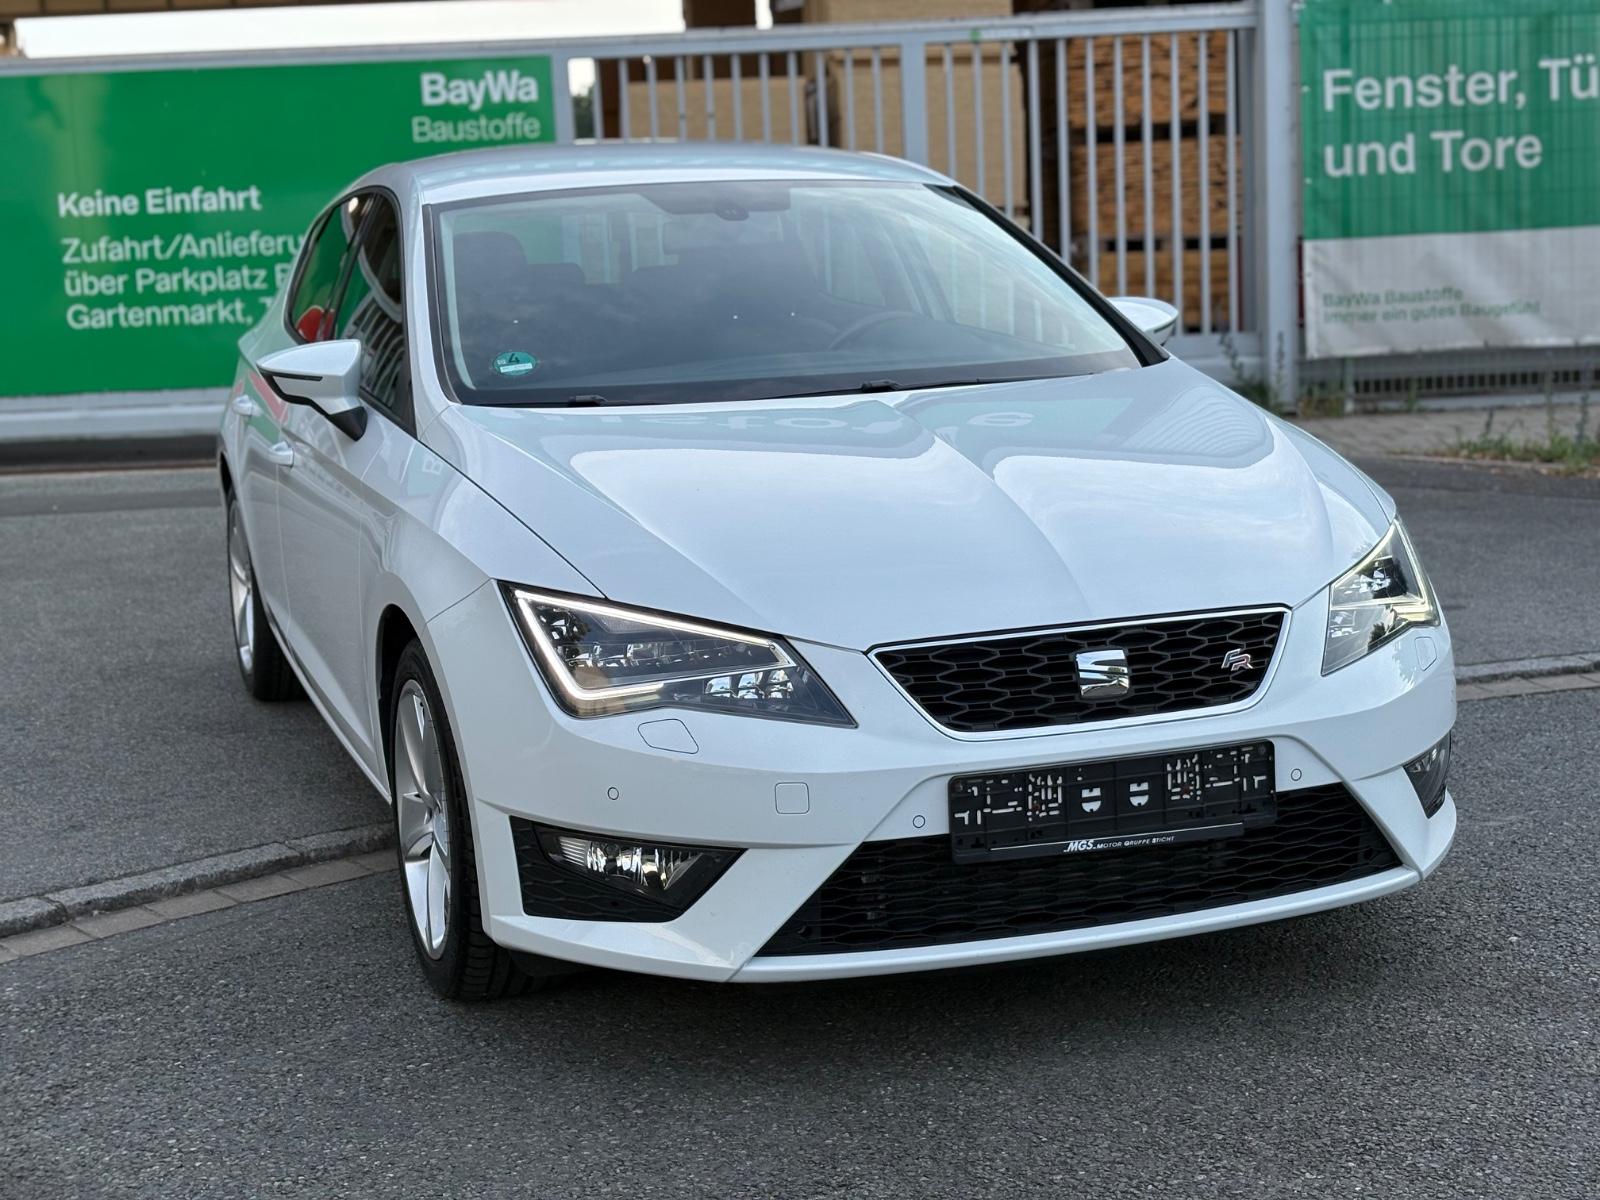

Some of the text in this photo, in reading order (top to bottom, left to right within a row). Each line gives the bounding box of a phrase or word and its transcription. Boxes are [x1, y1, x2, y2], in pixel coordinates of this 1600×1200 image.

[420, 69, 538, 111] BayWa
[1323, 54, 1600, 111] Fenster, Tü
[411, 112, 540, 143] Baustoffe
[1323, 130, 1543, 177] und Tore
[57, 185, 262, 218] Keine Einfahrt
[63, 269, 128, 297] über
[135, 263, 268, 294] Parkplatz
[66, 296, 253, 330] Gartenmarkt,
[1221, 648, 1253, 671] FR
